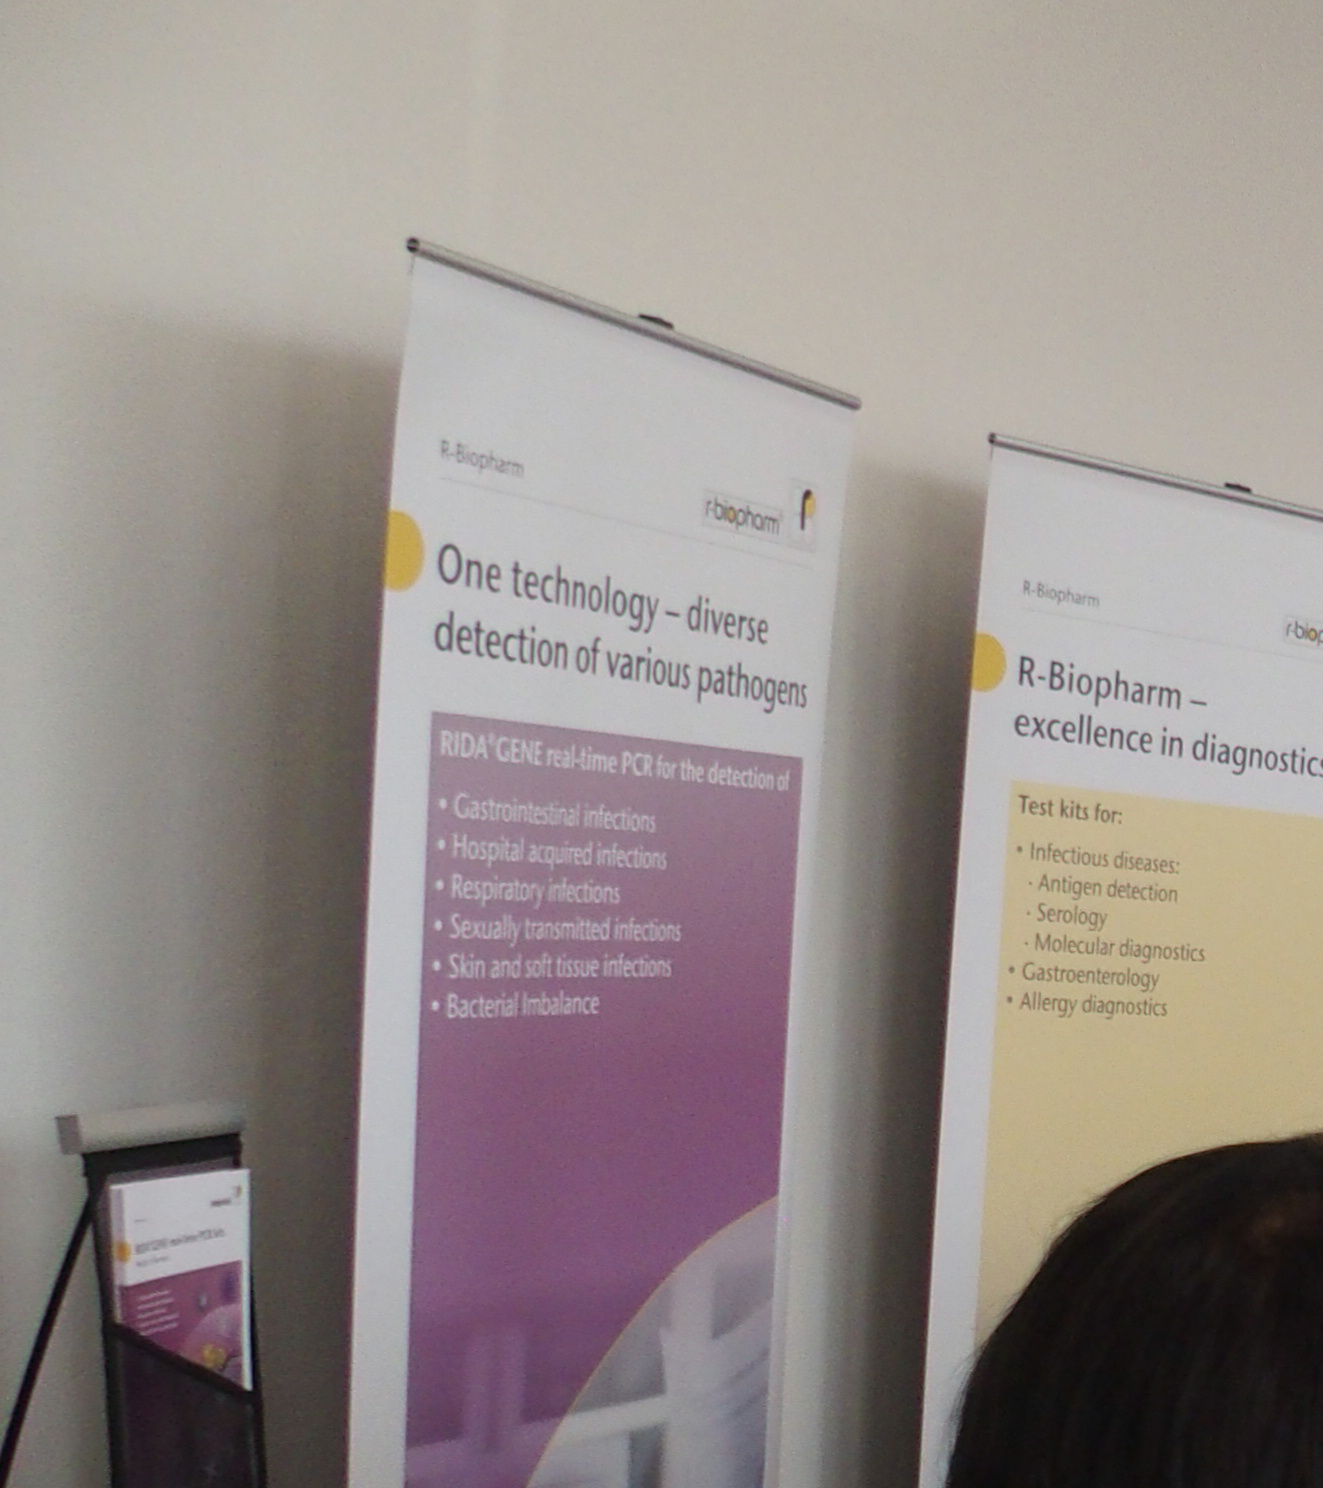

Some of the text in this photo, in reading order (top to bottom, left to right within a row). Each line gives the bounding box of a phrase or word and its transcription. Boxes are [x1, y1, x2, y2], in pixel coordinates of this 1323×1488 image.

[440, 440, 525, 478] R-Biopharm
[438, 543, 501, 594] One
[512, 559, 659, 635] technology
[687, 595, 769, 645] diverse
[1022, 580, 1100, 608] R-Biopharm
[434, 610, 808, 714] detection of various pathogens
[1018, 656, 1182, 710] R-Biopharm
[1014, 714, 1153, 754] excellence
[1161, 727, 1184, 758] in
[546, 744, 618, 774] real-time
[621, 751, 653, 777] PCR
[656, 754, 677, 779] for
[680, 758, 704, 783] the
[708, 762, 774, 790] detection
[776, 769, 791, 791] of
[454, 791, 656, 833] Gastrointestinal infections
[1018, 795, 1123, 825] Test kits for:
[451, 833, 667, 870] Hospital acquired infections
[1030, 842, 1180, 875] Infectious diseases:
[452, 873, 621, 910] Respiratory infections
[1038, 873, 1179, 903] Antigen detection
[450, 913, 682, 948] Sexually transmitted infections
[1036, 903, 1107, 932] Serology
[1034, 933, 1206, 964] Molecular diagnostics
[449, 953, 672, 979] Skin and soft tissue infections
[1022, 962, 1160, 991] Gastroenterology
[448, 991, 519, 1018] Bacterial
[1019, 991, 1168, 1019] Allergy diagnostics
